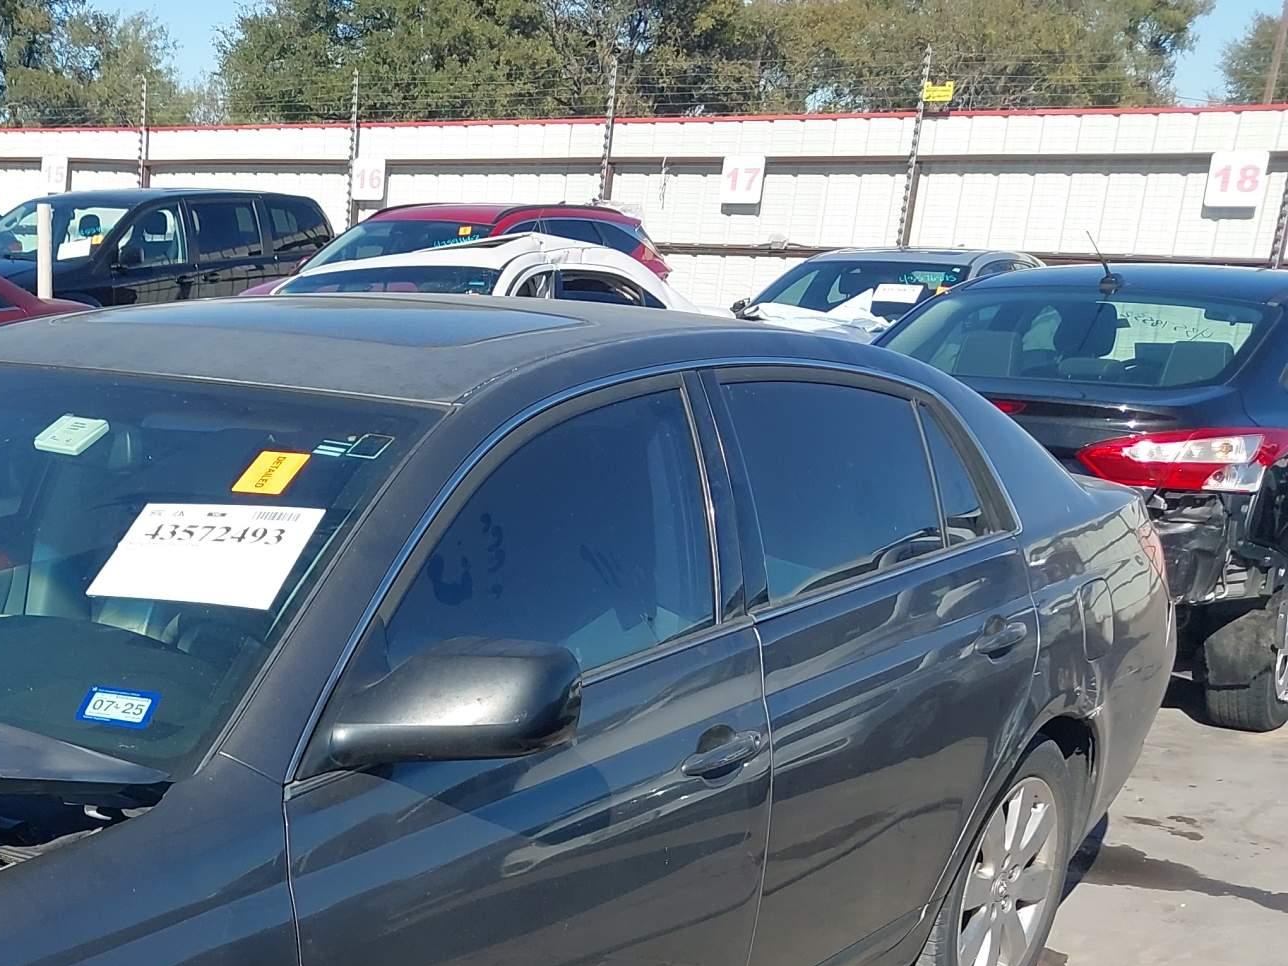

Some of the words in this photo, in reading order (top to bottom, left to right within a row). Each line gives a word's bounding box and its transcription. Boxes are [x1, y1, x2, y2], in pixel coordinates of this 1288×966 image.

[44, 166, 65, 183] 15
[356, 169, 381, 189] 16
[727, 167, 761, 191] 17
[1214, 164, 1261, 193] 18
[254, 456, 287, 488] DETAILED
[145, 523, 286, 545] 43572493
[92, 699, 117, 712] 07
[121, 702, 146, 716] 25
